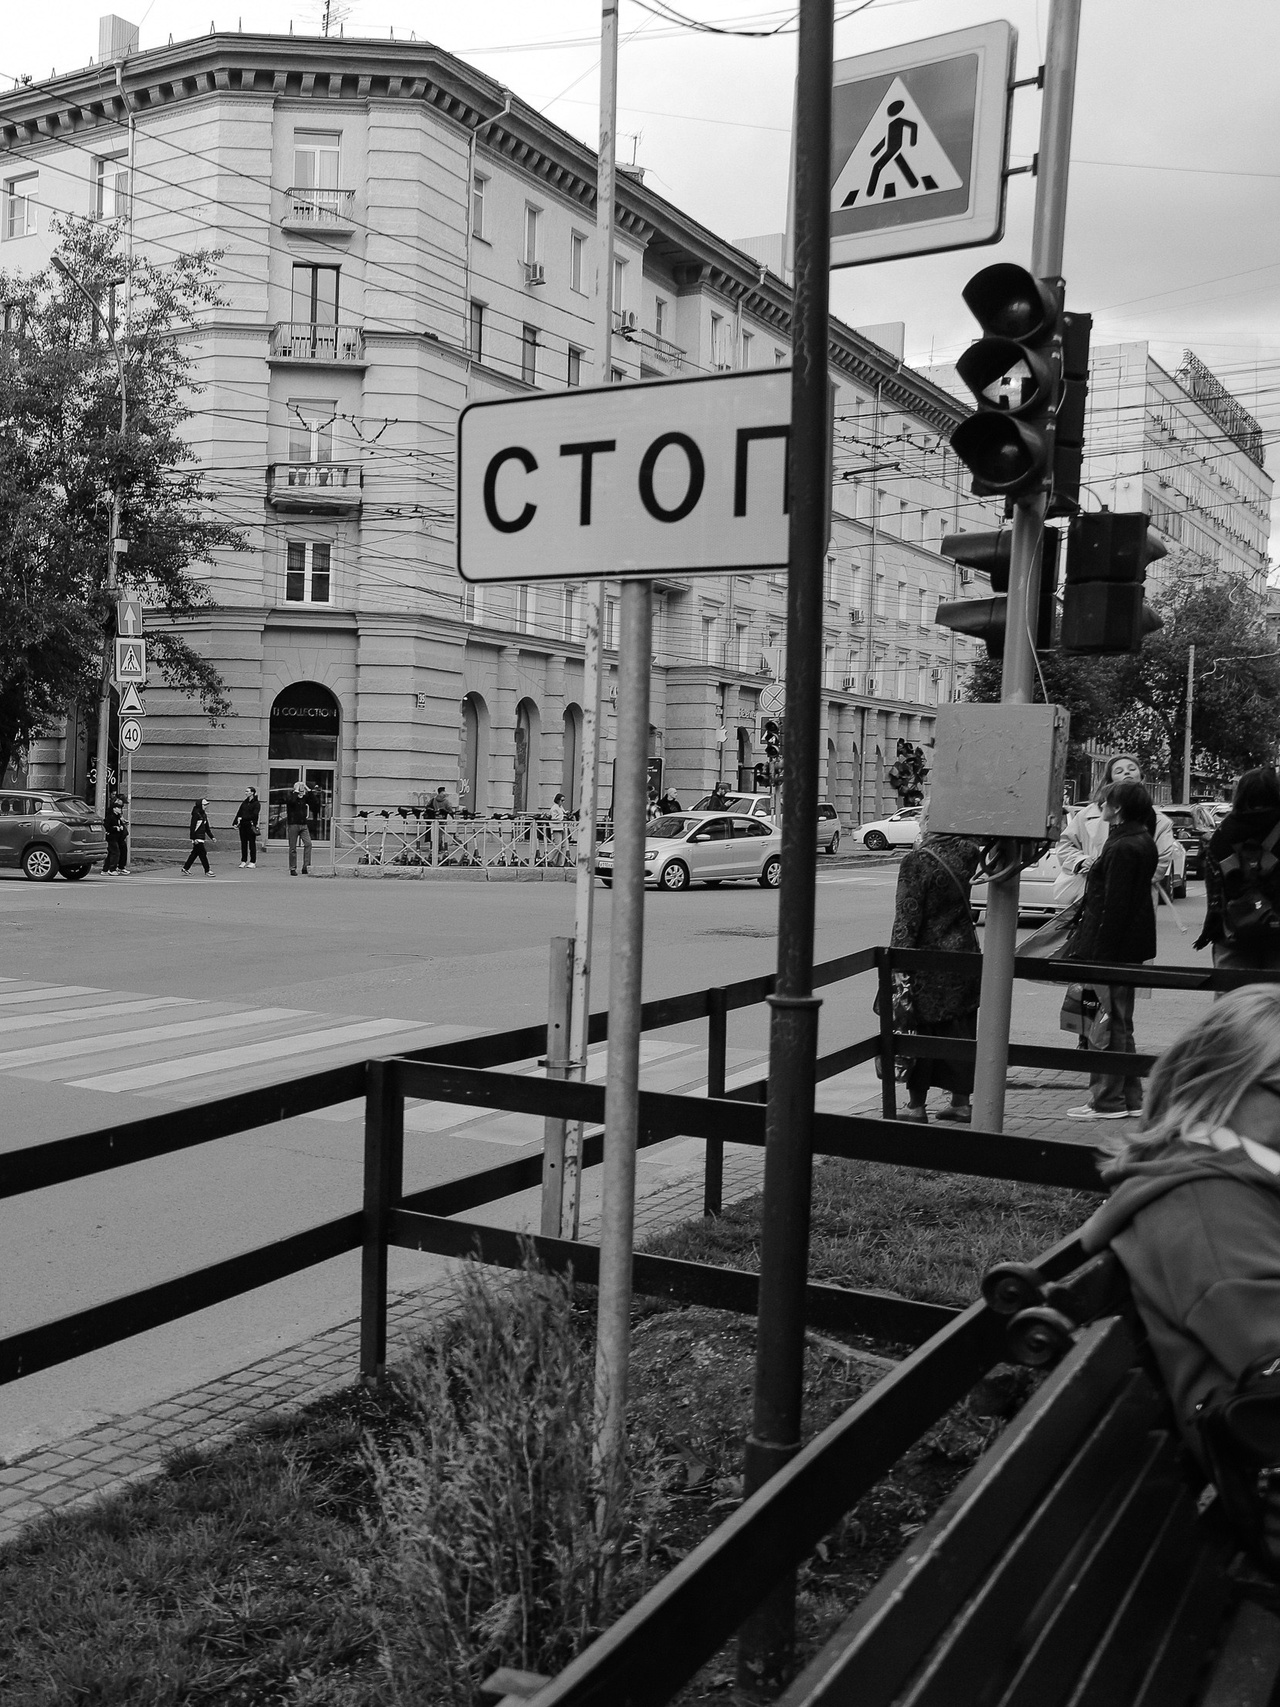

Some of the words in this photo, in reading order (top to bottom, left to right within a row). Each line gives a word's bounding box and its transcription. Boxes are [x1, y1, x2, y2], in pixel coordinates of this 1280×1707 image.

[483, 425, 790, 533] СТОП
[124, 728, 139, 742] 40
[86, 768, 116, 785] -3%
